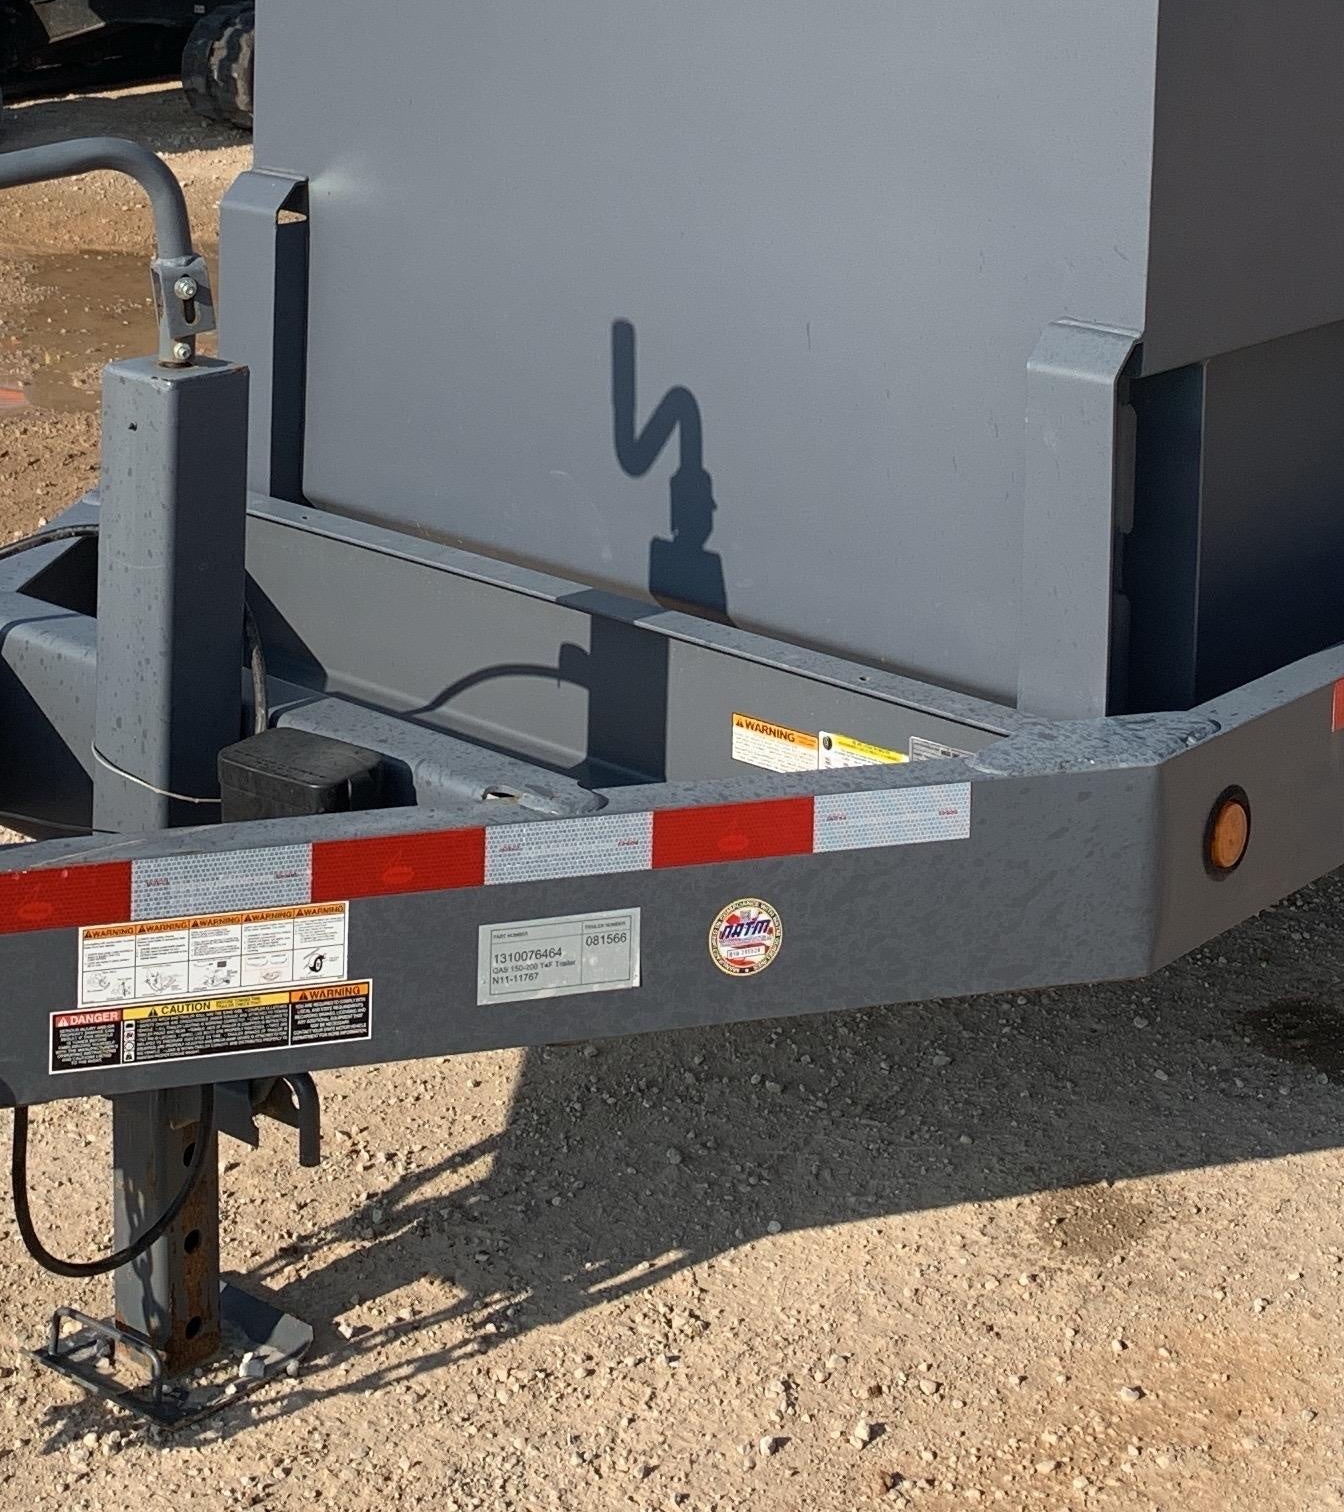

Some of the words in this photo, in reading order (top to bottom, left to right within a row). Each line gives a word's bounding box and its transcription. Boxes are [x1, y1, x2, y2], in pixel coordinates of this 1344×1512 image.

[744, 718, 796, 744] WARNING
[251, 910, 293, 921] WARNING
[303, 905, 344, 916] WARNING
[146, 922, 187, 932] WARNING
[199, 916, 241, 926] WARNING
[91, 927, 134, 938] WARNING
[585, 932, 627, 946] 081566
[494, 947, 562, 964] 1310076464
[511, 962, 538, 973] 150-200
[492, 972, 539, 984] N11-11767
[309, 986, 361, 999] WARNING
[161, 1000, 211, 1014] CAUTION
[69, 1011, 119, 1025] DANGER
